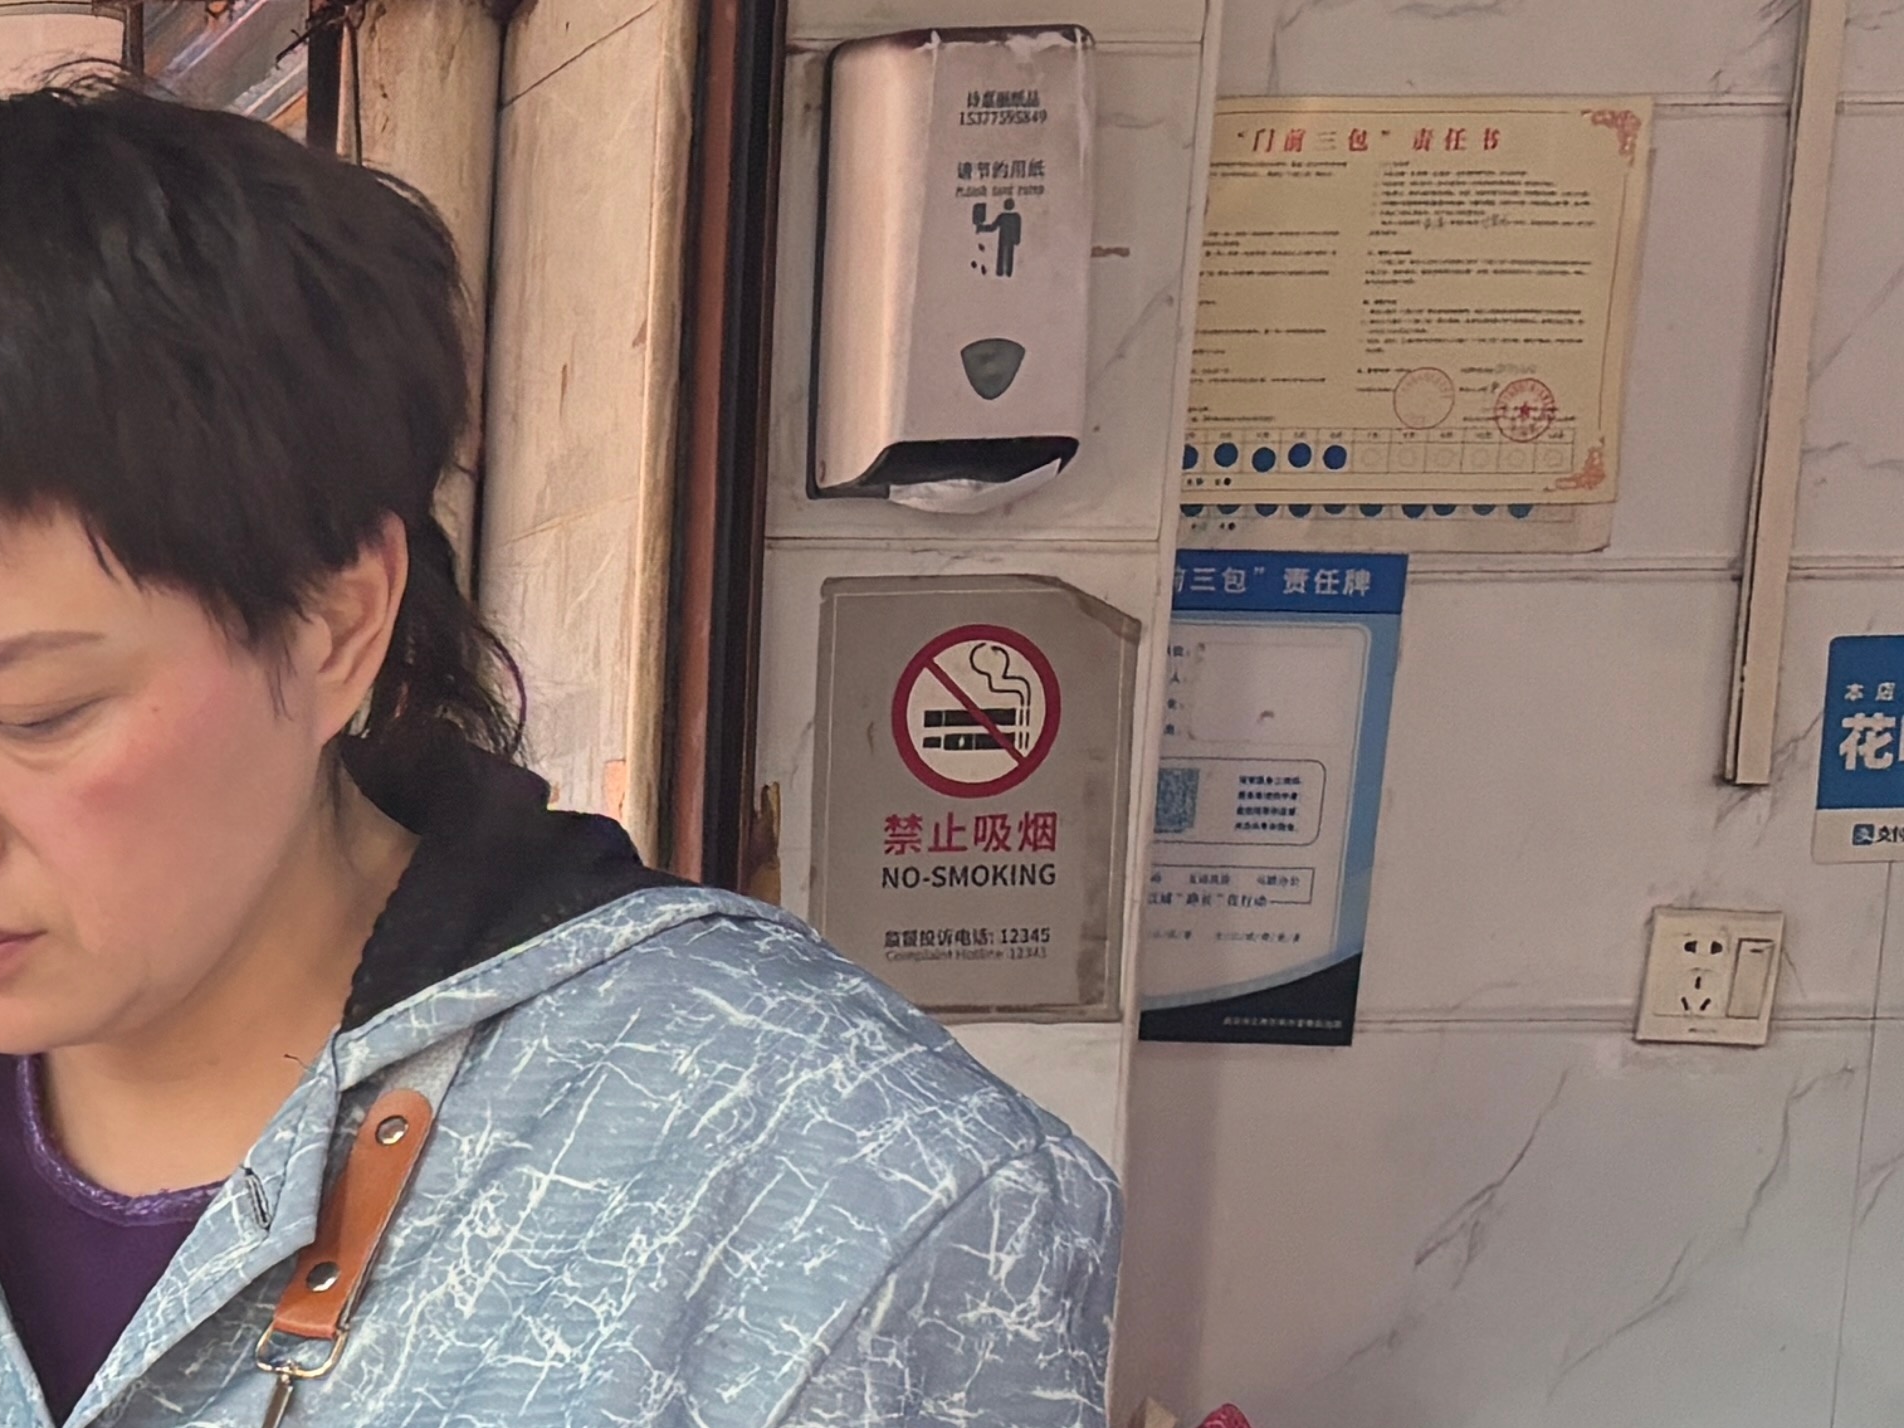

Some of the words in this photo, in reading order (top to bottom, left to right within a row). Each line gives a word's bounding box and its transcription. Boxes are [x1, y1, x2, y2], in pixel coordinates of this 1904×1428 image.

[1839, 712, 1904, 771] 花
[884, 811, 1058, 855] 禁止吸烟
[881, 863, 1057, 889] NO-SMOKING
[1001, 927, 1051, 944] 12345
